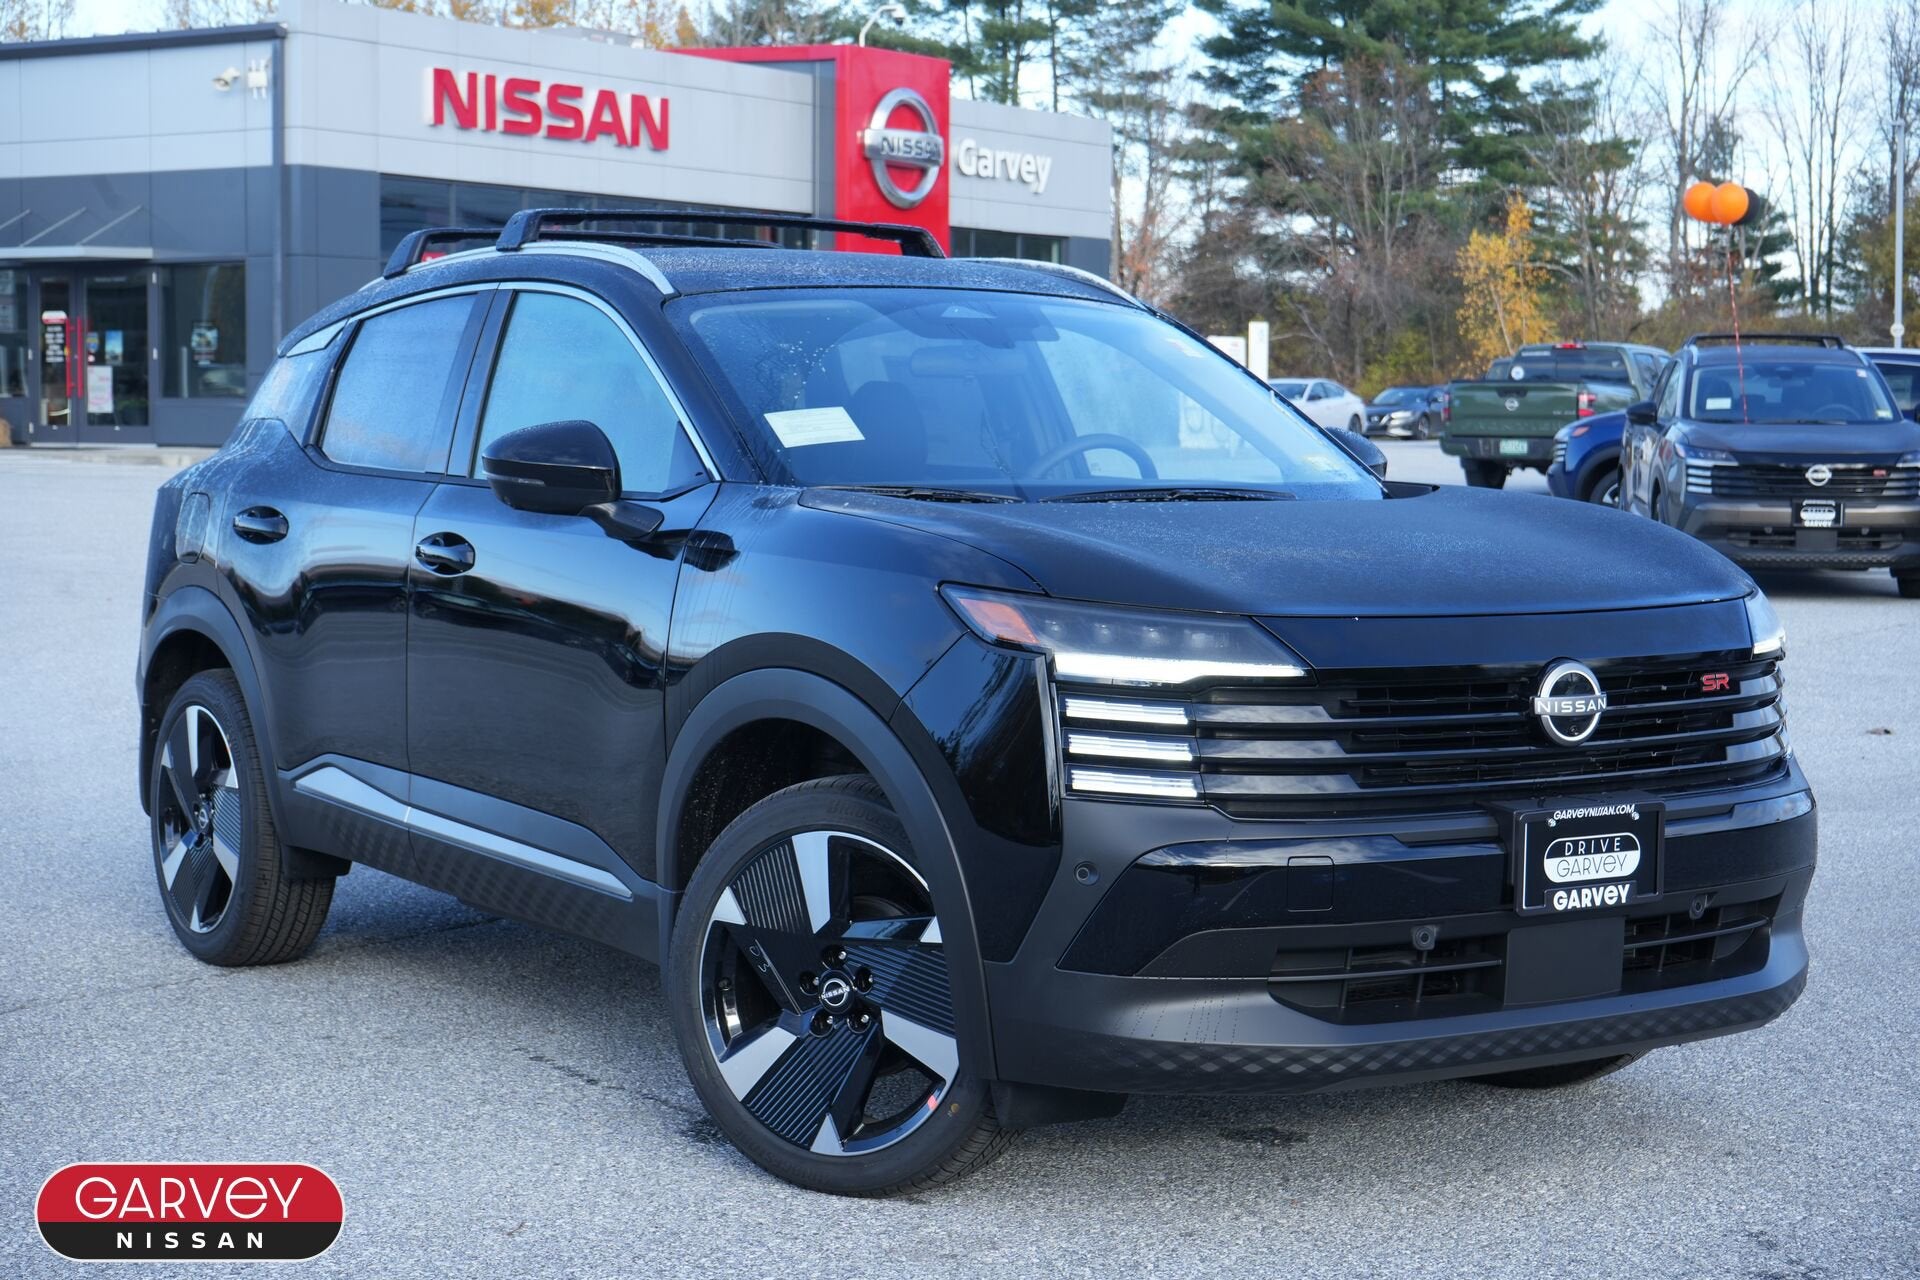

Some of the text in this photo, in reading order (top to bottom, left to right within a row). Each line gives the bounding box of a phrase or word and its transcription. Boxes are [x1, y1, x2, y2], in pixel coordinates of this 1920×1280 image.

[430, 68, 669, 152] NISSAN
[957, 137, 1053, 194] Garvey
[1701, 672, 1730, 692] SR
[1537, 697, 1607, 714] NISSAN
[1564, 837, 1621, 856] DRIVE
[820, 984, 851, 1001] NISSAN
